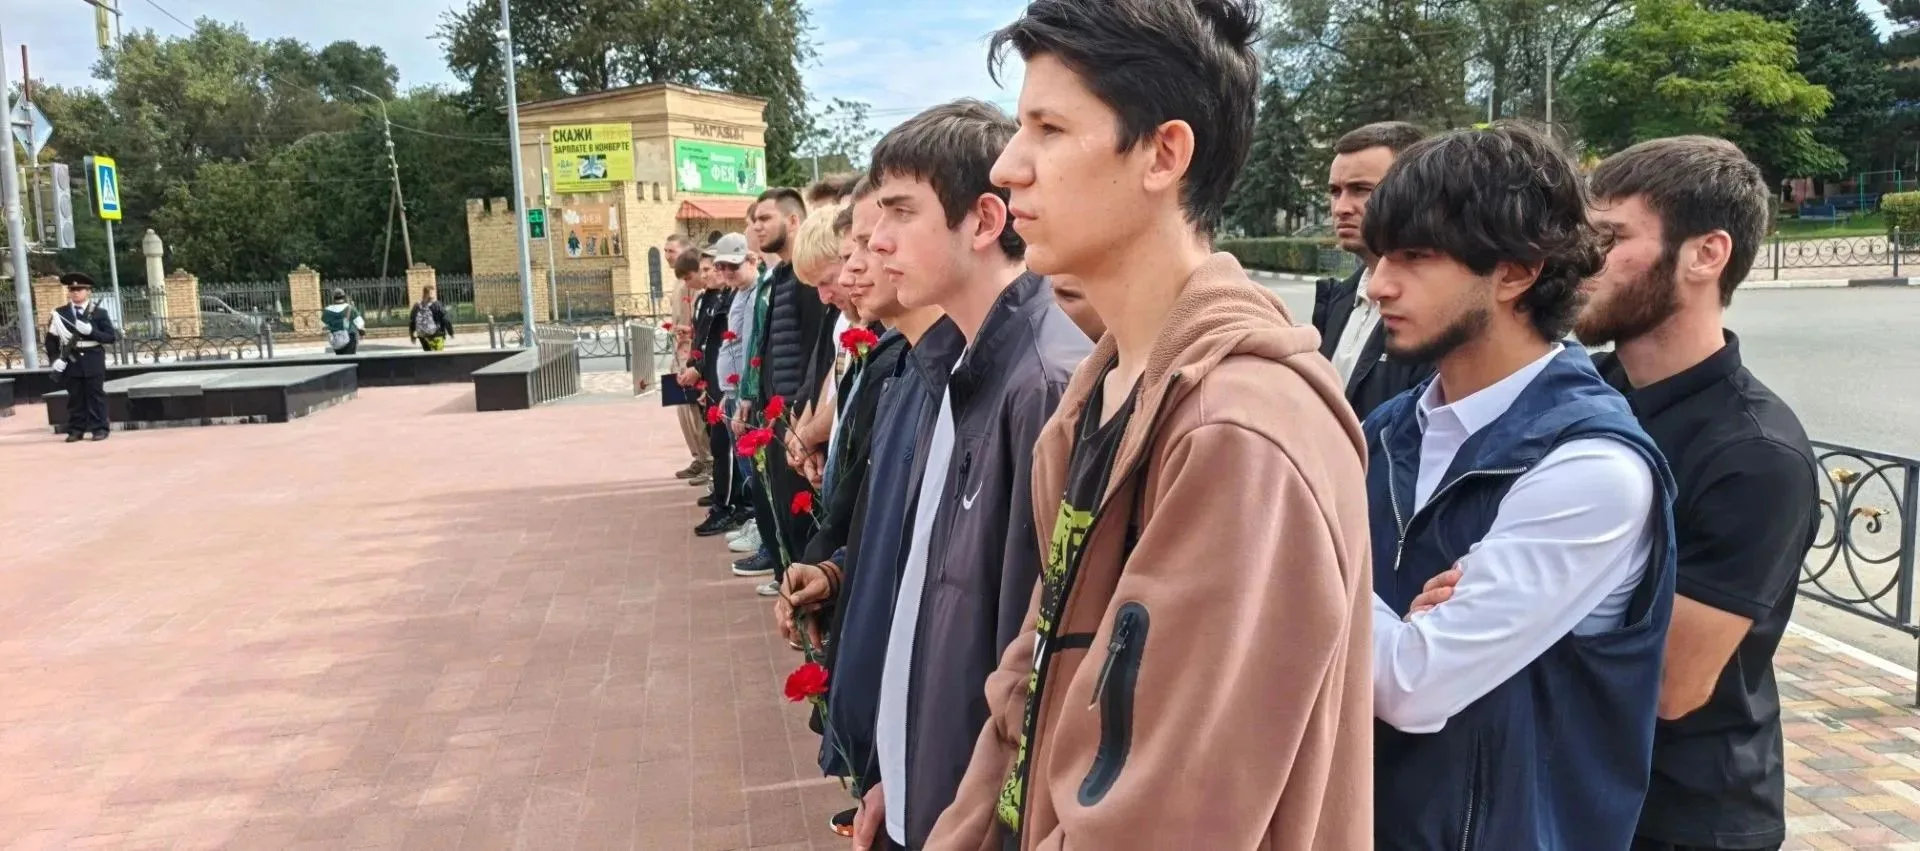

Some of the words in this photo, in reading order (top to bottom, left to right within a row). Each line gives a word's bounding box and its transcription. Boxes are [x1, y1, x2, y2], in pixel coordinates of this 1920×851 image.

[553, 128, 592, 142] СКАЖИ
[693, 122, 745, 140] МАГАЗИН
[554, 144, 587, 154] ЗАРПЛАТЕ
[589, 144, 594, 152] В
[595, 141, 630, 151] КОНВЕРТЕ
[711, 164, 735, 184] ФЕЯ
